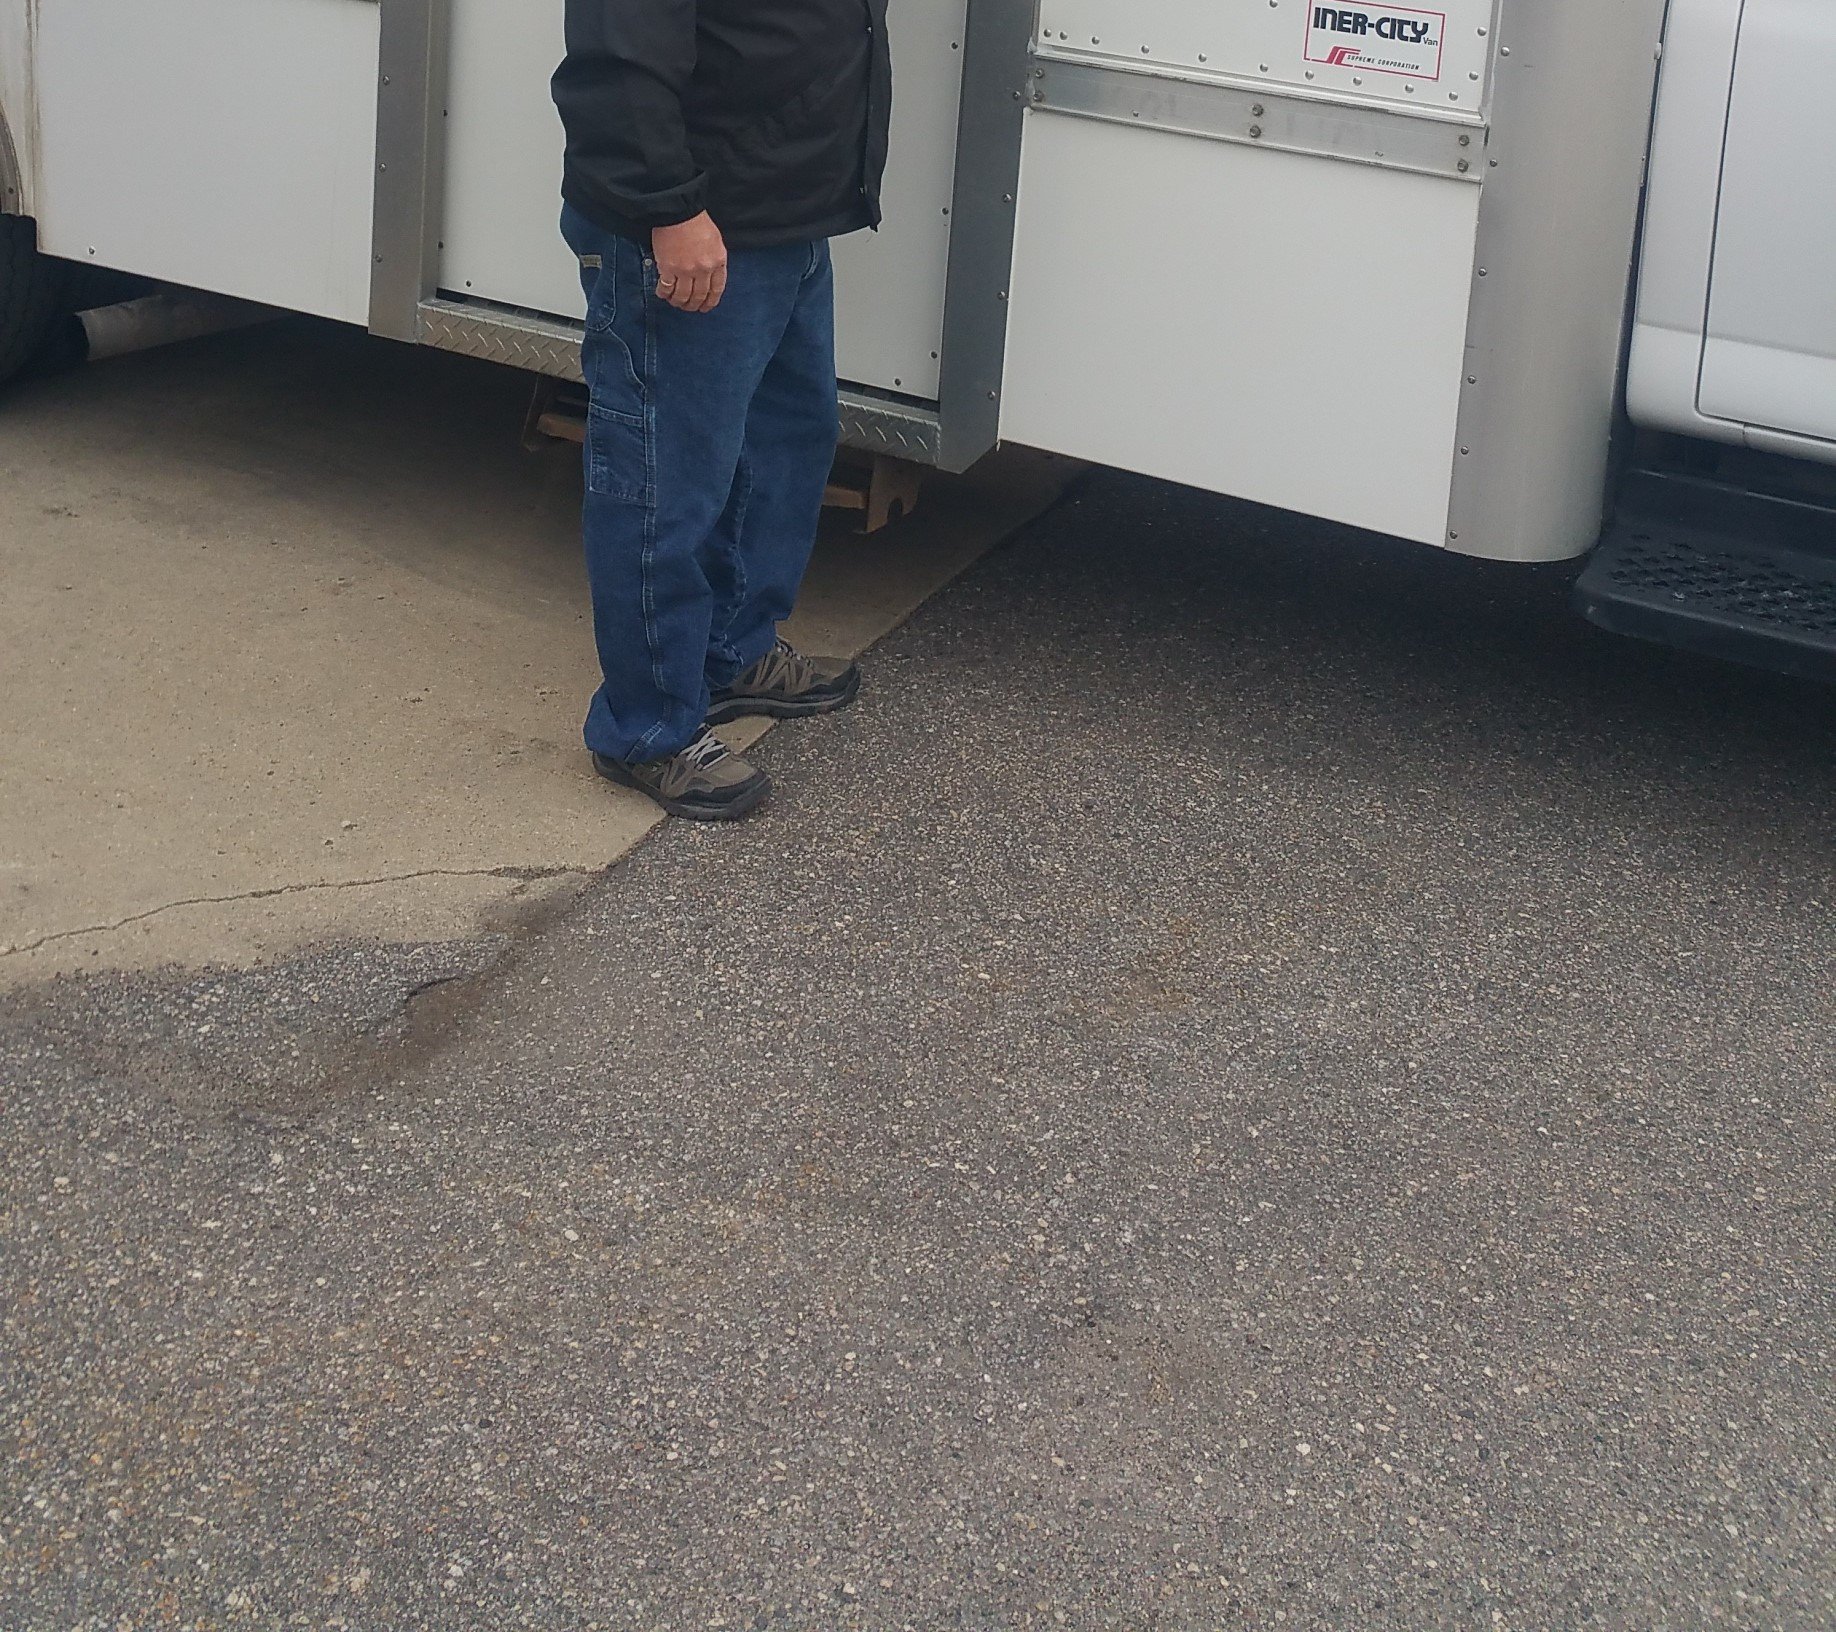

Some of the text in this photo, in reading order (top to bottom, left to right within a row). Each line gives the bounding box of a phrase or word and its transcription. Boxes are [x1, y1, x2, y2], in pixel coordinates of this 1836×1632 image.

[1313, 6, 1438, 46] INER-CITY Van
[1347, 54, 1420, 71] SUPREME CORPORATION
